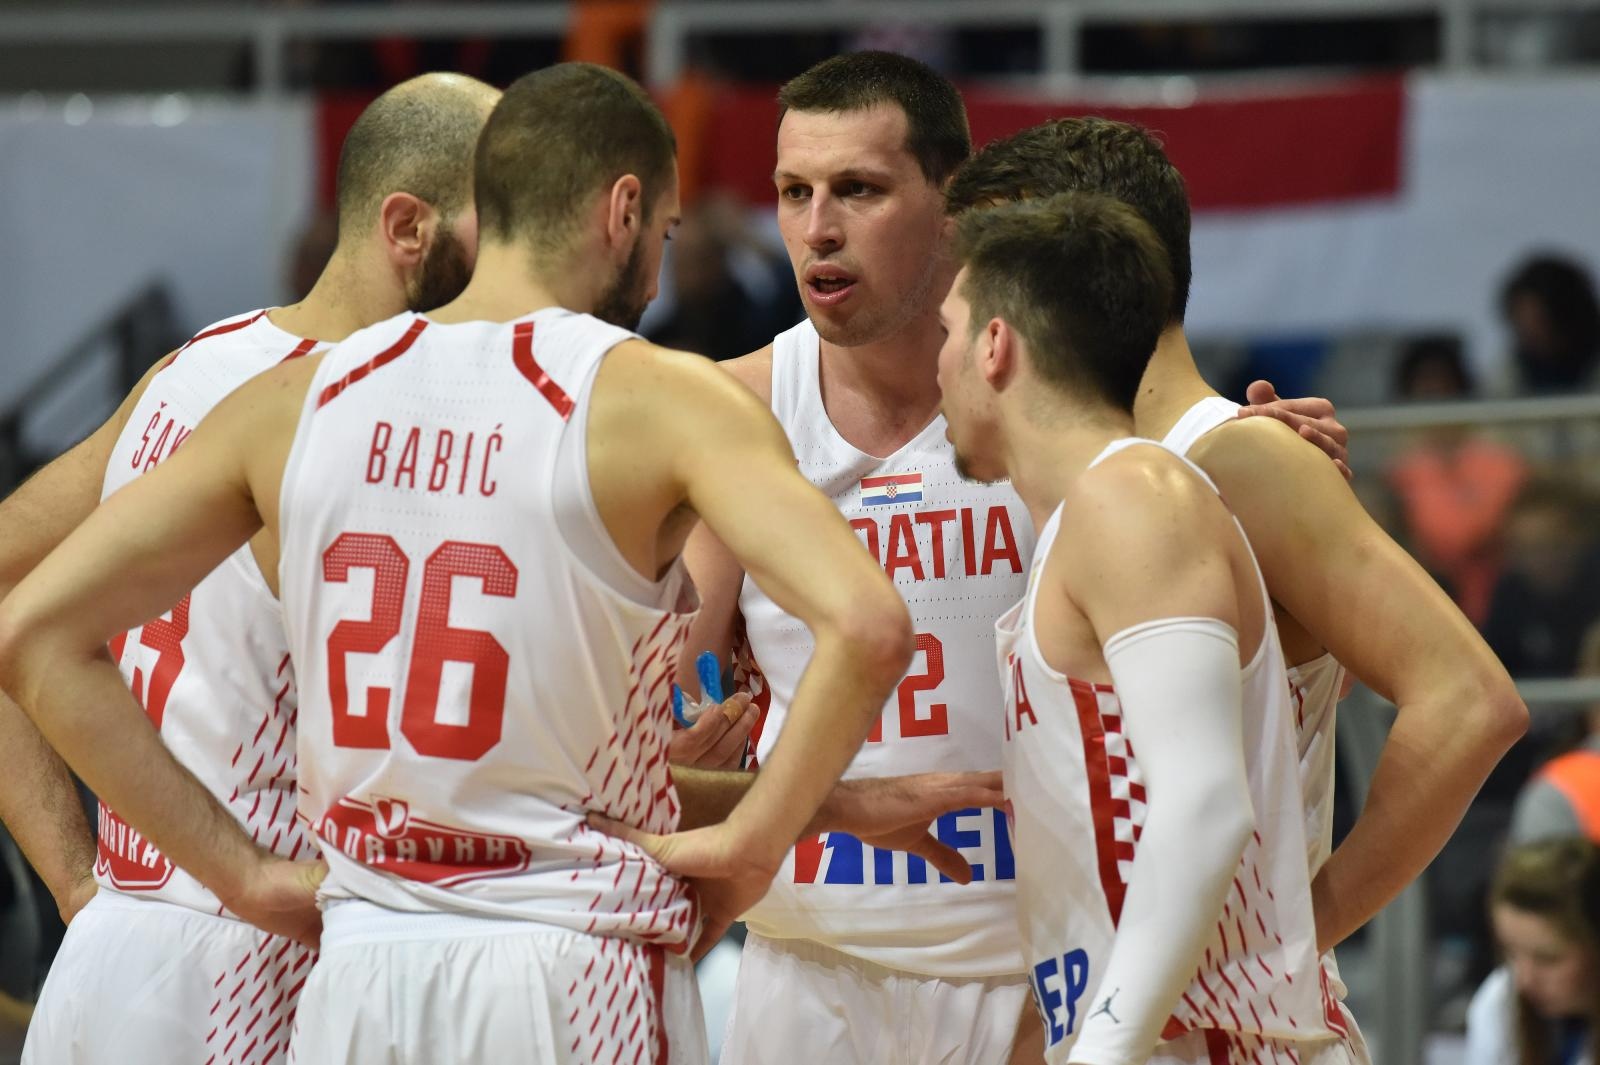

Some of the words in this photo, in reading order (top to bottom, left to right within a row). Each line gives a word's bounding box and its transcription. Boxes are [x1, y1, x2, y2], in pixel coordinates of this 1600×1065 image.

[366, 422, 503, 497] BABIĆ
[107, 592, 192, 733] 3
[323, 532, 518, 762] 26
[867, 632, 949, 743] 2
[1028, 948, 1089, 1047] EP
